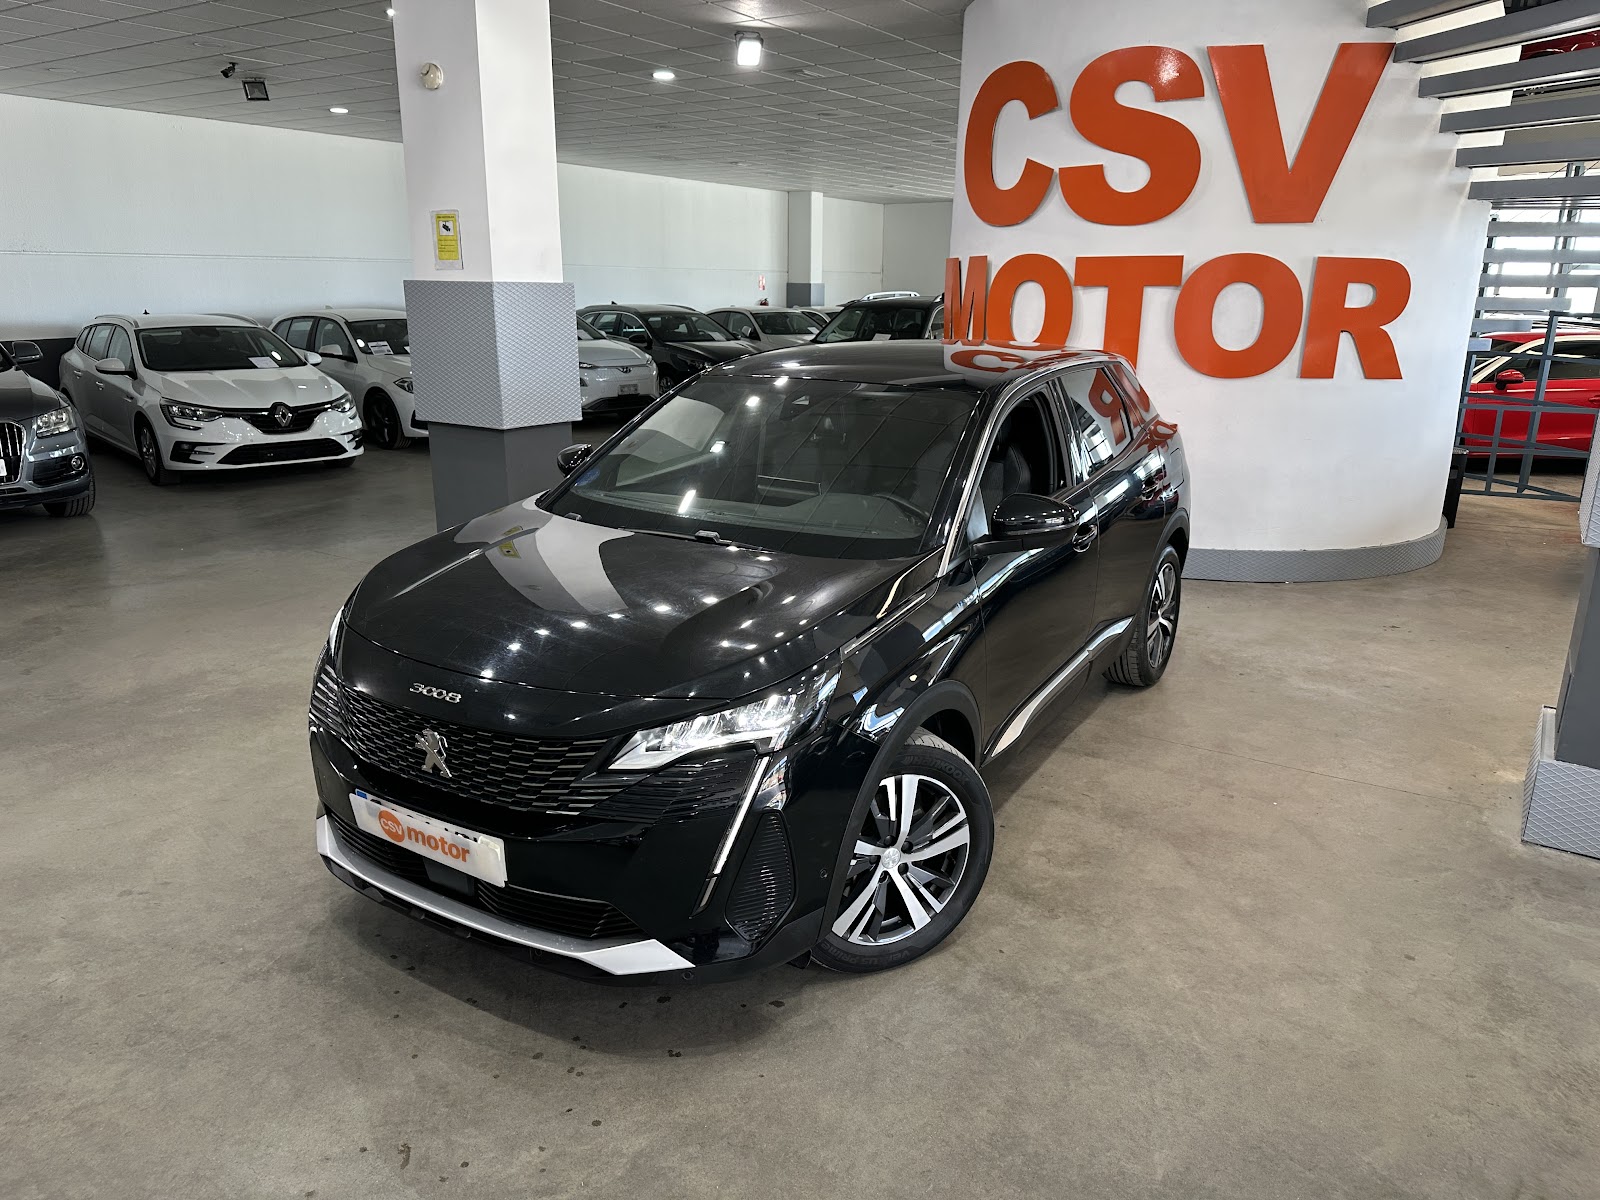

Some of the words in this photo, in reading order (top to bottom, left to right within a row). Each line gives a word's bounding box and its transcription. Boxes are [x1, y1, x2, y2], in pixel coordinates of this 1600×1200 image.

[964, 42, 1396, 227] CSV
[944, 253, 1411, 380] MOTOR
[410, 682, 462, 704] 3008
[406, 825, 471, 863] motor
